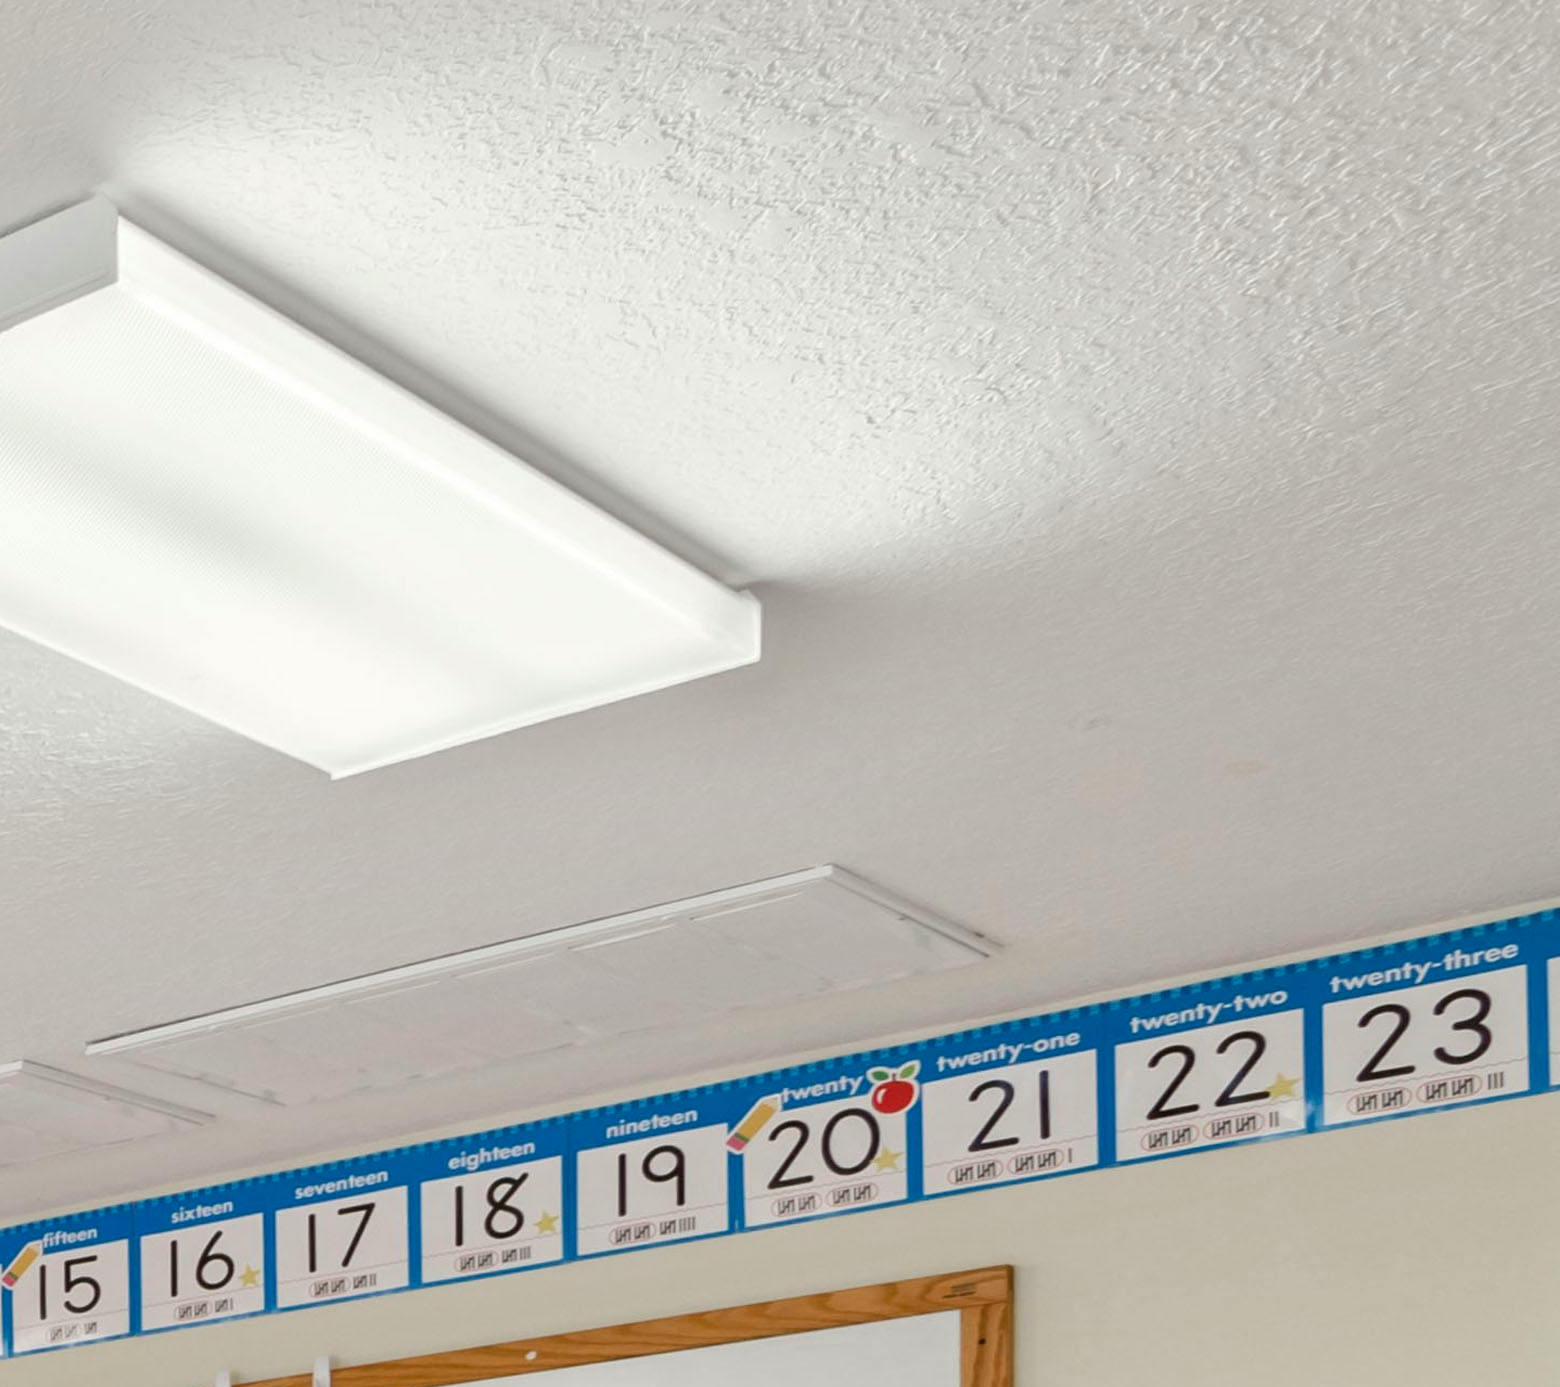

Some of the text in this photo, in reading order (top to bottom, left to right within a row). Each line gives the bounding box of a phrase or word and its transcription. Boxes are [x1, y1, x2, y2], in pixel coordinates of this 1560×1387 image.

[1329, 941, 1520, 995] twenty-three
[1129, 986, 1289, 1034] twenty-two
[1355, 987, 1494, 1084] 23
[936, 1029, 1082, 1074] twenty-one
[1145, 1029, 1273, 1122] 22
[781, 1073, 864, 1104] twenty
[967, 1069, 1052, 1153] 21
[605, 1107, 698, 1139] nineteen
[766, 1106, 882, 1190] 20
[293, 1167, 389, 1200] seventeen
[446, 1139, 537, 1172] eighteen
[617, 1144, 687, 1218] 19
[41, 1224, 99, 1249] fifteen
[169, 1198, 235, 1225] sixteen
[306, 1202, 378, 1274] 17
[453, 1171, 530, 1248] 18
[38, 1254, 103, 1321] 15
[169, 1230, 236, 1298] 16
